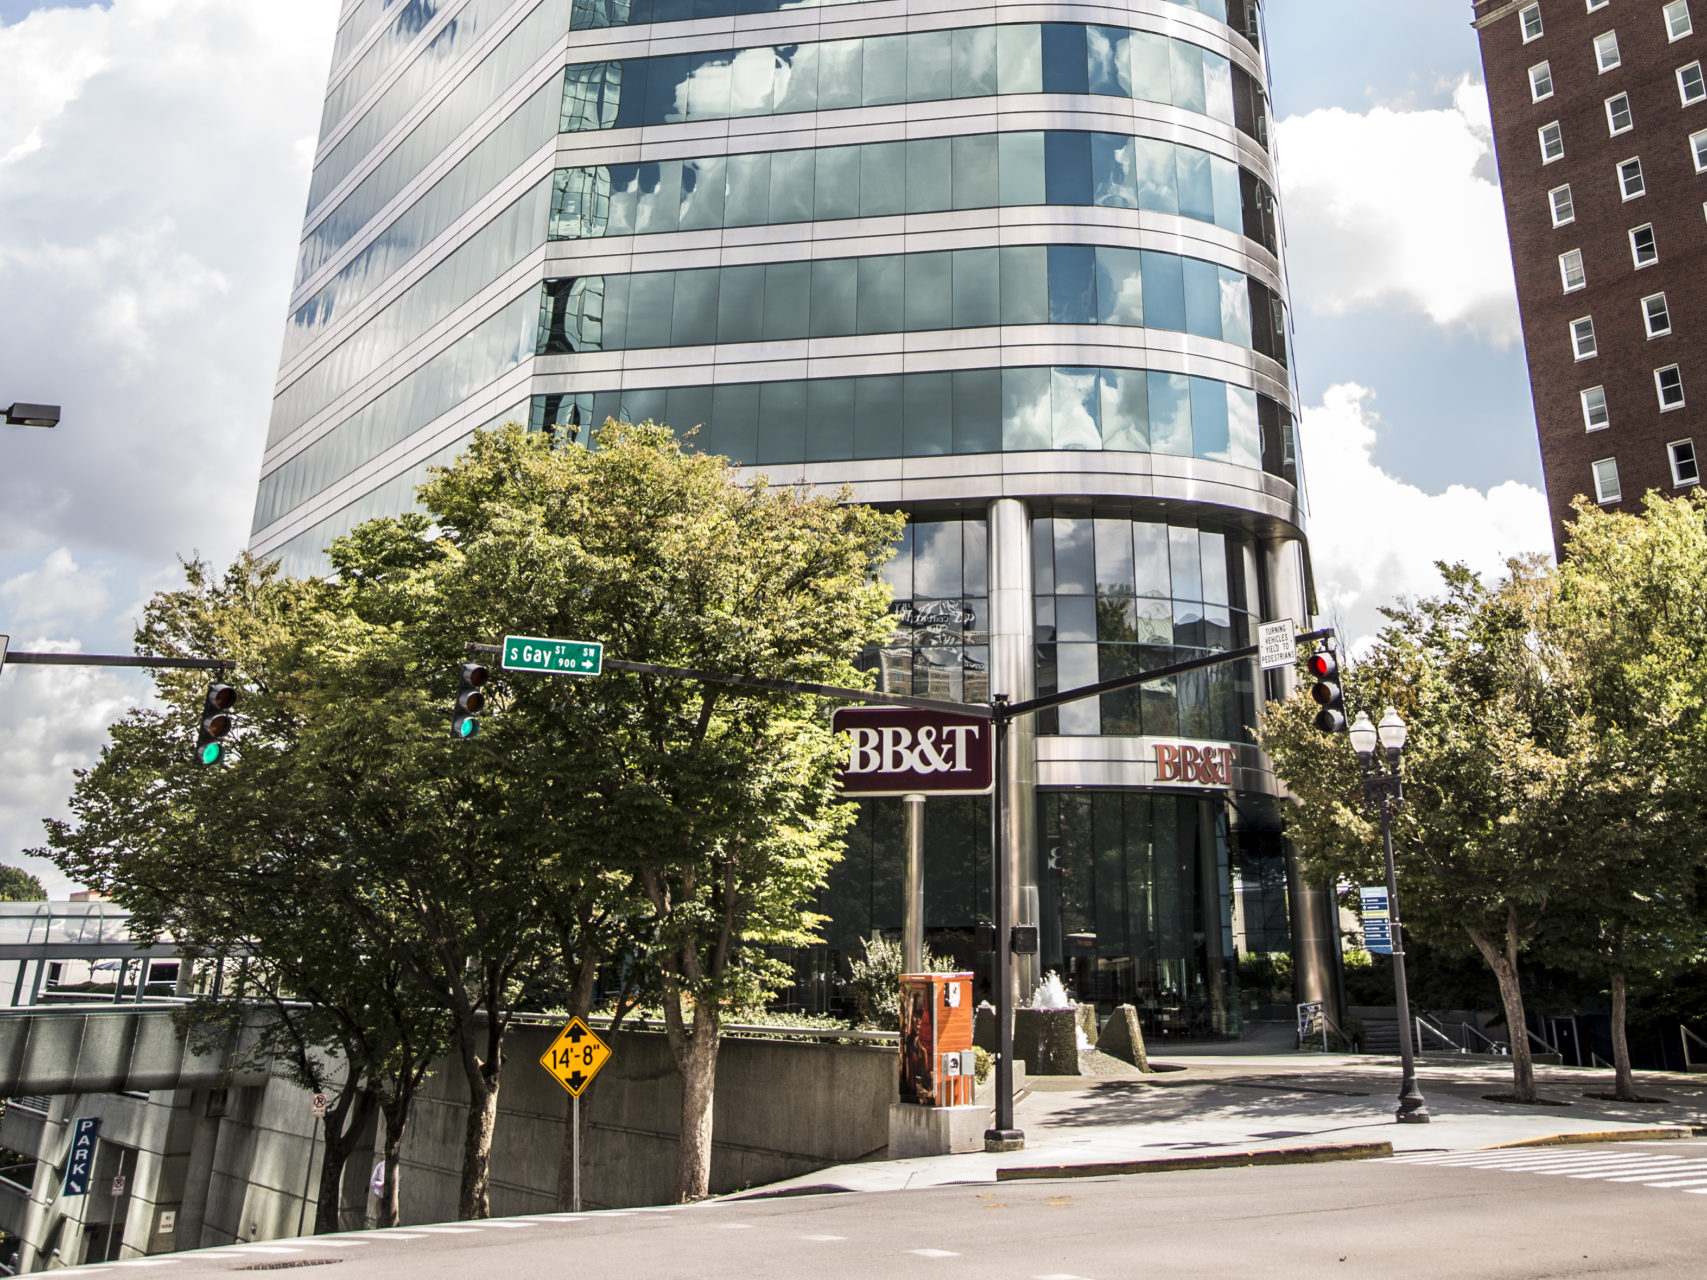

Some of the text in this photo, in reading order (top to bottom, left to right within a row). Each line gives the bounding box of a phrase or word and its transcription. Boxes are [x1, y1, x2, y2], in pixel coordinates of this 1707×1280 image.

[1265, 624, 1287, 634] TURNING
[1265, 633, 1289, 645] VEHICLES
[1265, 642, 1290, 654] YIELD TO
[522, 645, 552, 668] Gay
[554, 645, 567, 655] ST
[582, 647, 596, 658] SW
[558, 657, 577, 669] 900
[1261, 650, 1295, 664] PEDESTRIANS
[845, 725, 980, 775] BB&T
[1152, 743, 1237, 786] BB&T
[551, 1043, 601, 1071] 14'-8"
[72, 1120, 94, 1175] PARK
